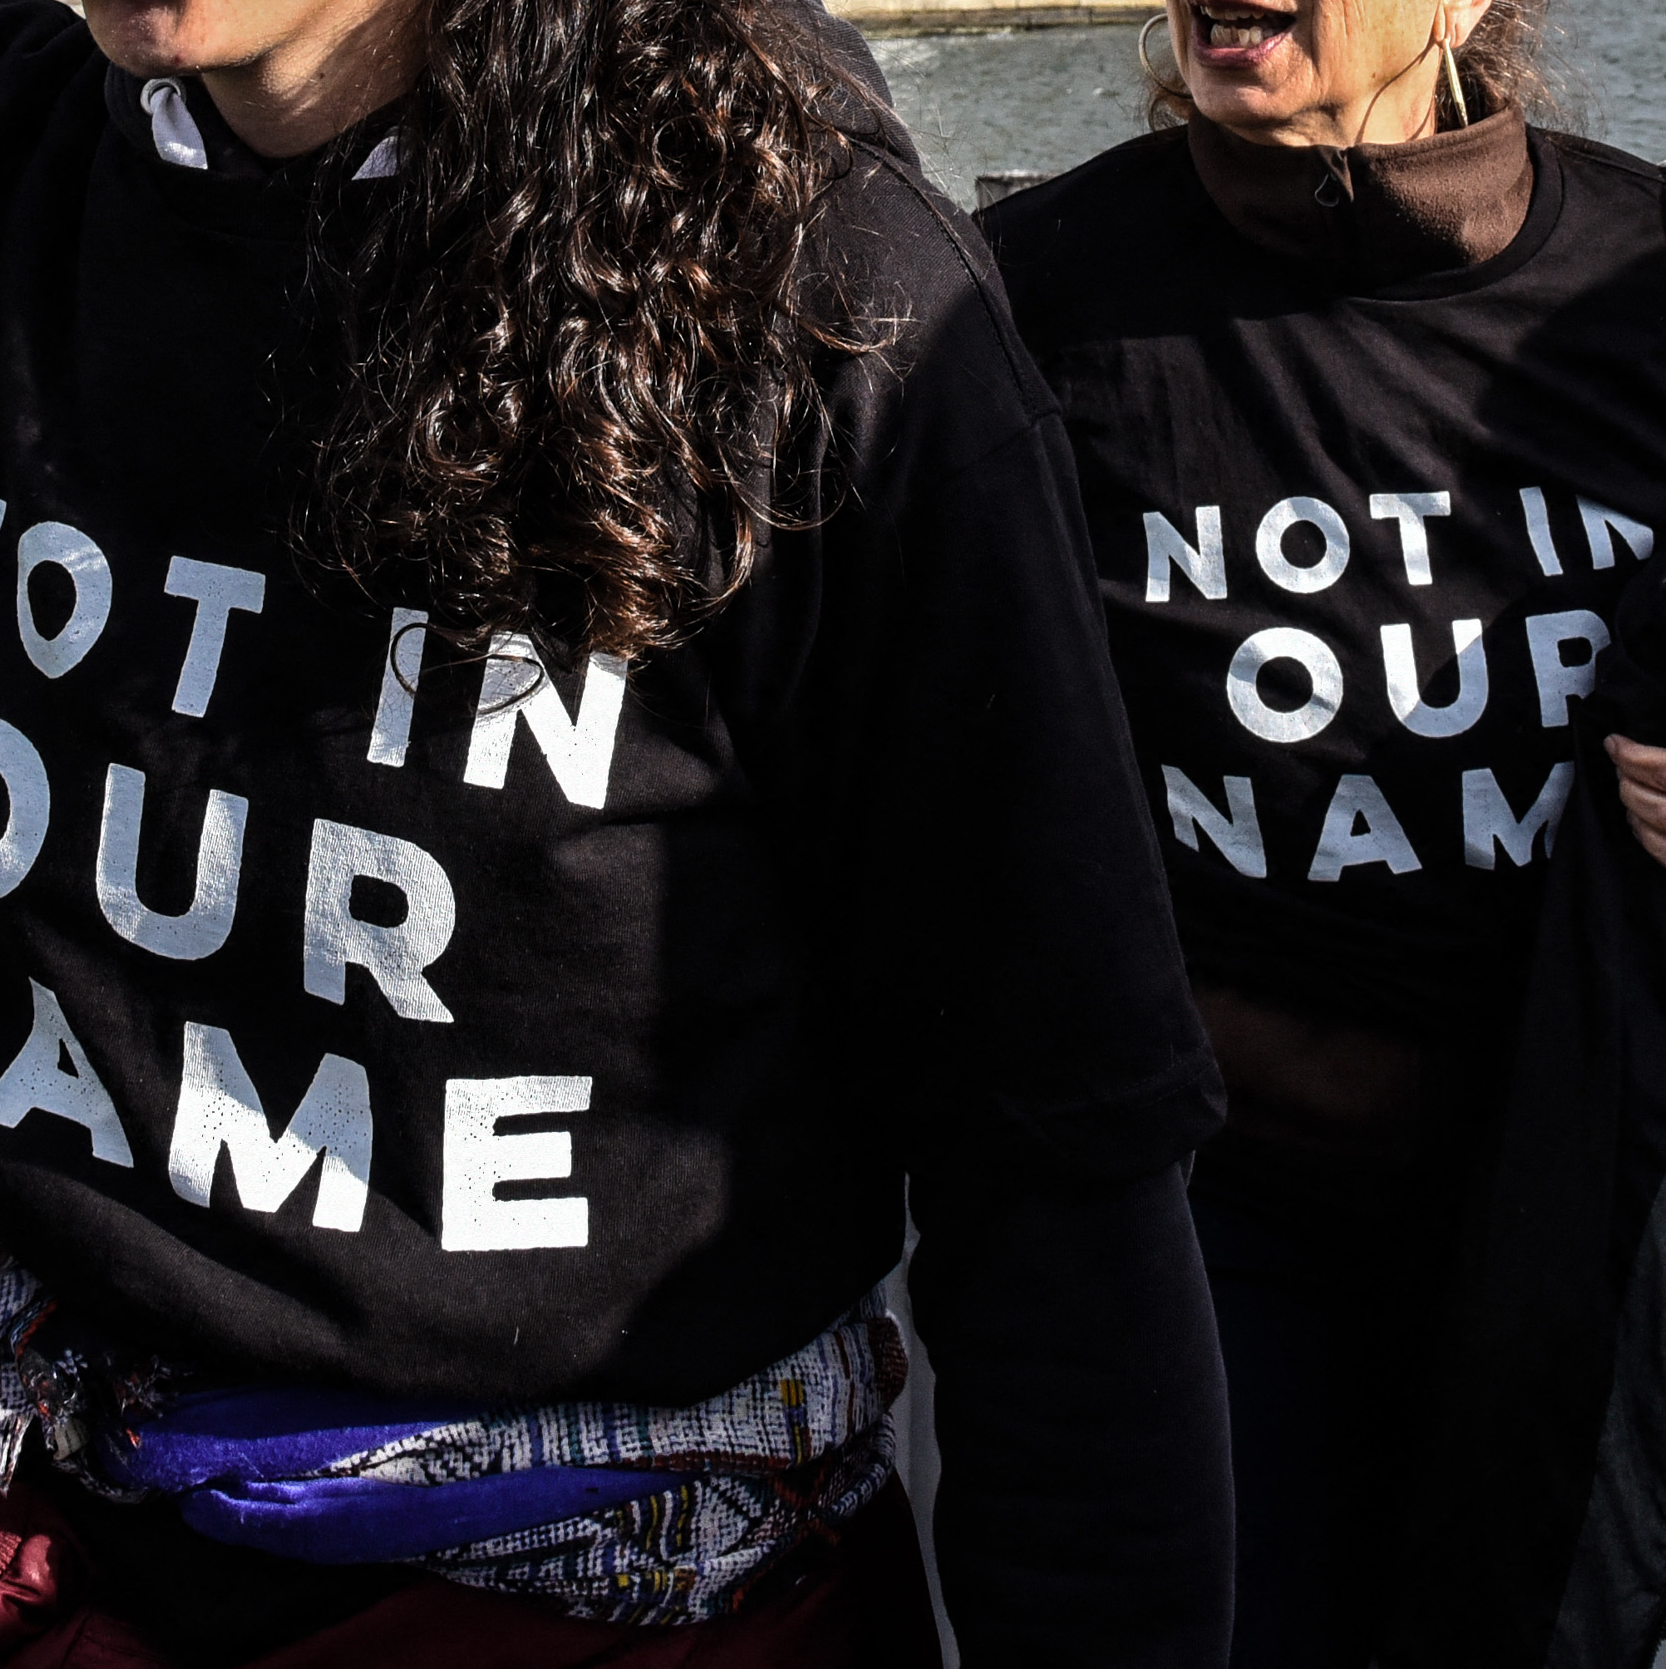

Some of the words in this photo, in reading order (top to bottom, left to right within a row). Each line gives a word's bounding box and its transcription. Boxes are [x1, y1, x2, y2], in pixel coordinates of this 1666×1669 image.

[1142, 489, 1452, 604] NOT
[365, 606, 631, 811] IN
[1160, 763, 1576, 883] NAM
